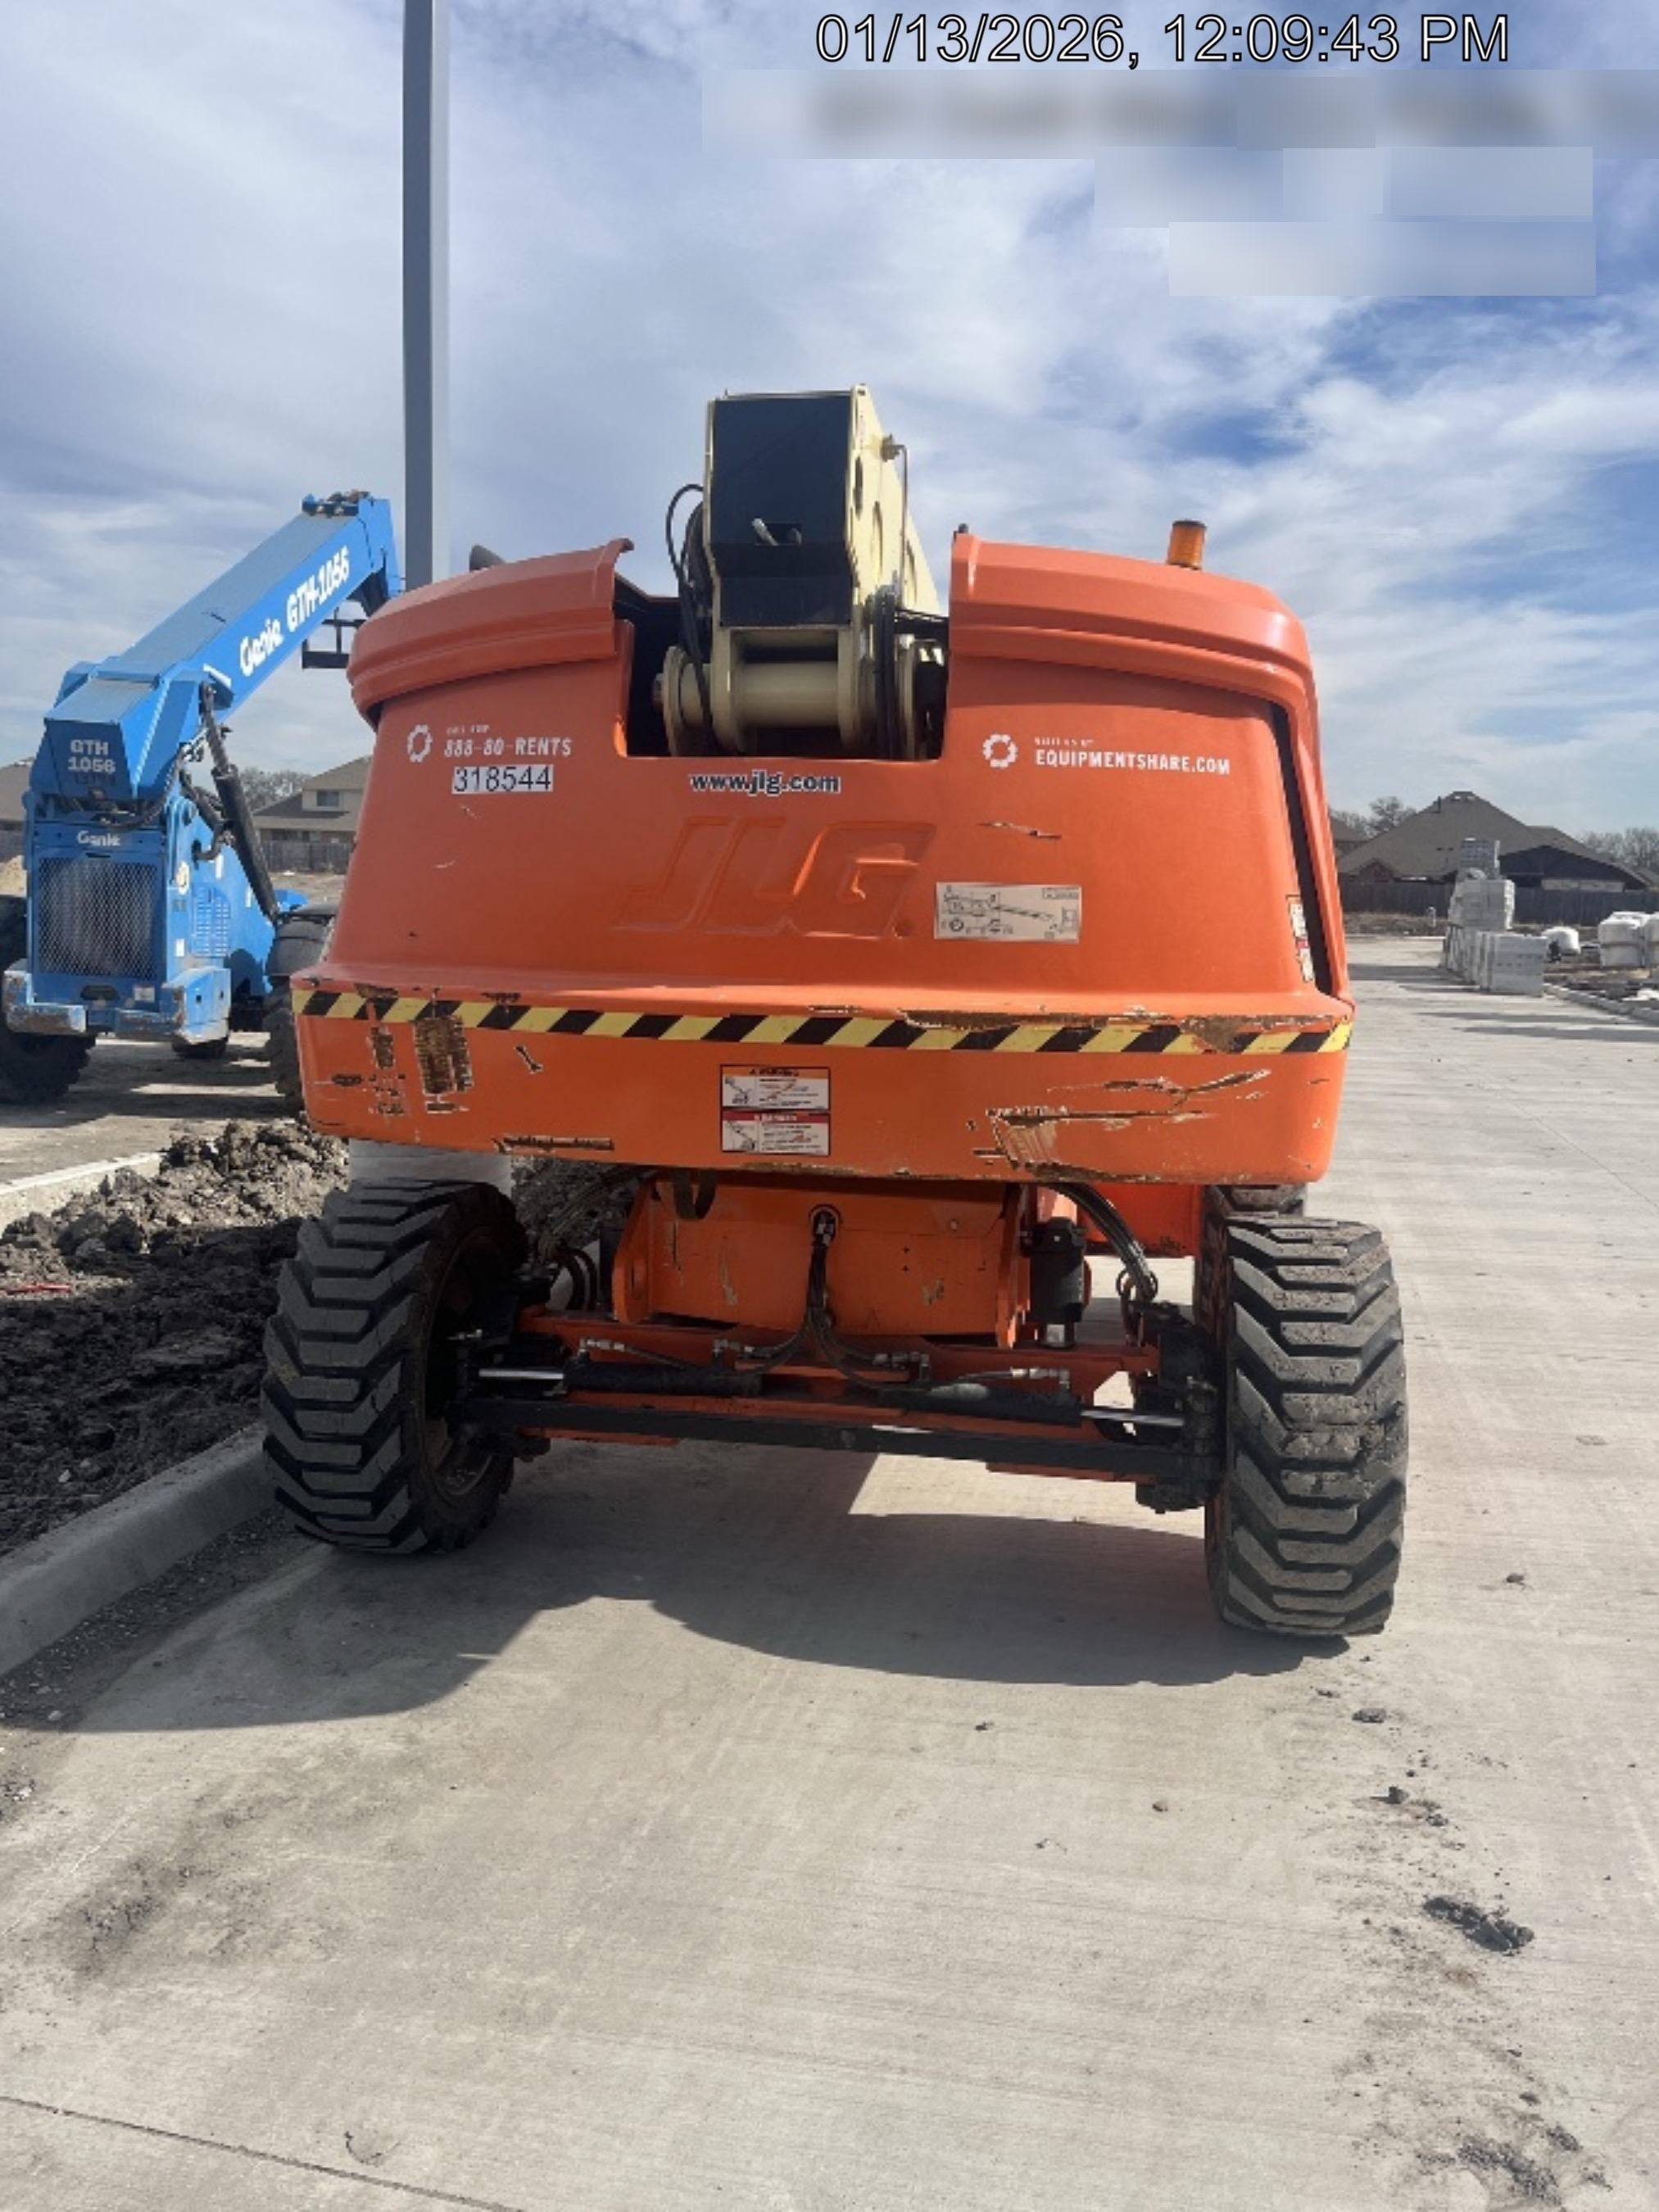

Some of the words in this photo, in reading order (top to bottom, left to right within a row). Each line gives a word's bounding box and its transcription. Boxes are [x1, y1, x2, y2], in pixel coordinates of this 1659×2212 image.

[240, 619, 284, 678] Genie
[70, 739, 109, 756] GTH
[1036, 749, 1231, 775] EQUIPMENTSHARE.COM
[454, 766, 552, 792] 318544
[688, 768, 841, 796] www.jlg.com
[610, 814, 936, 941] JLG
